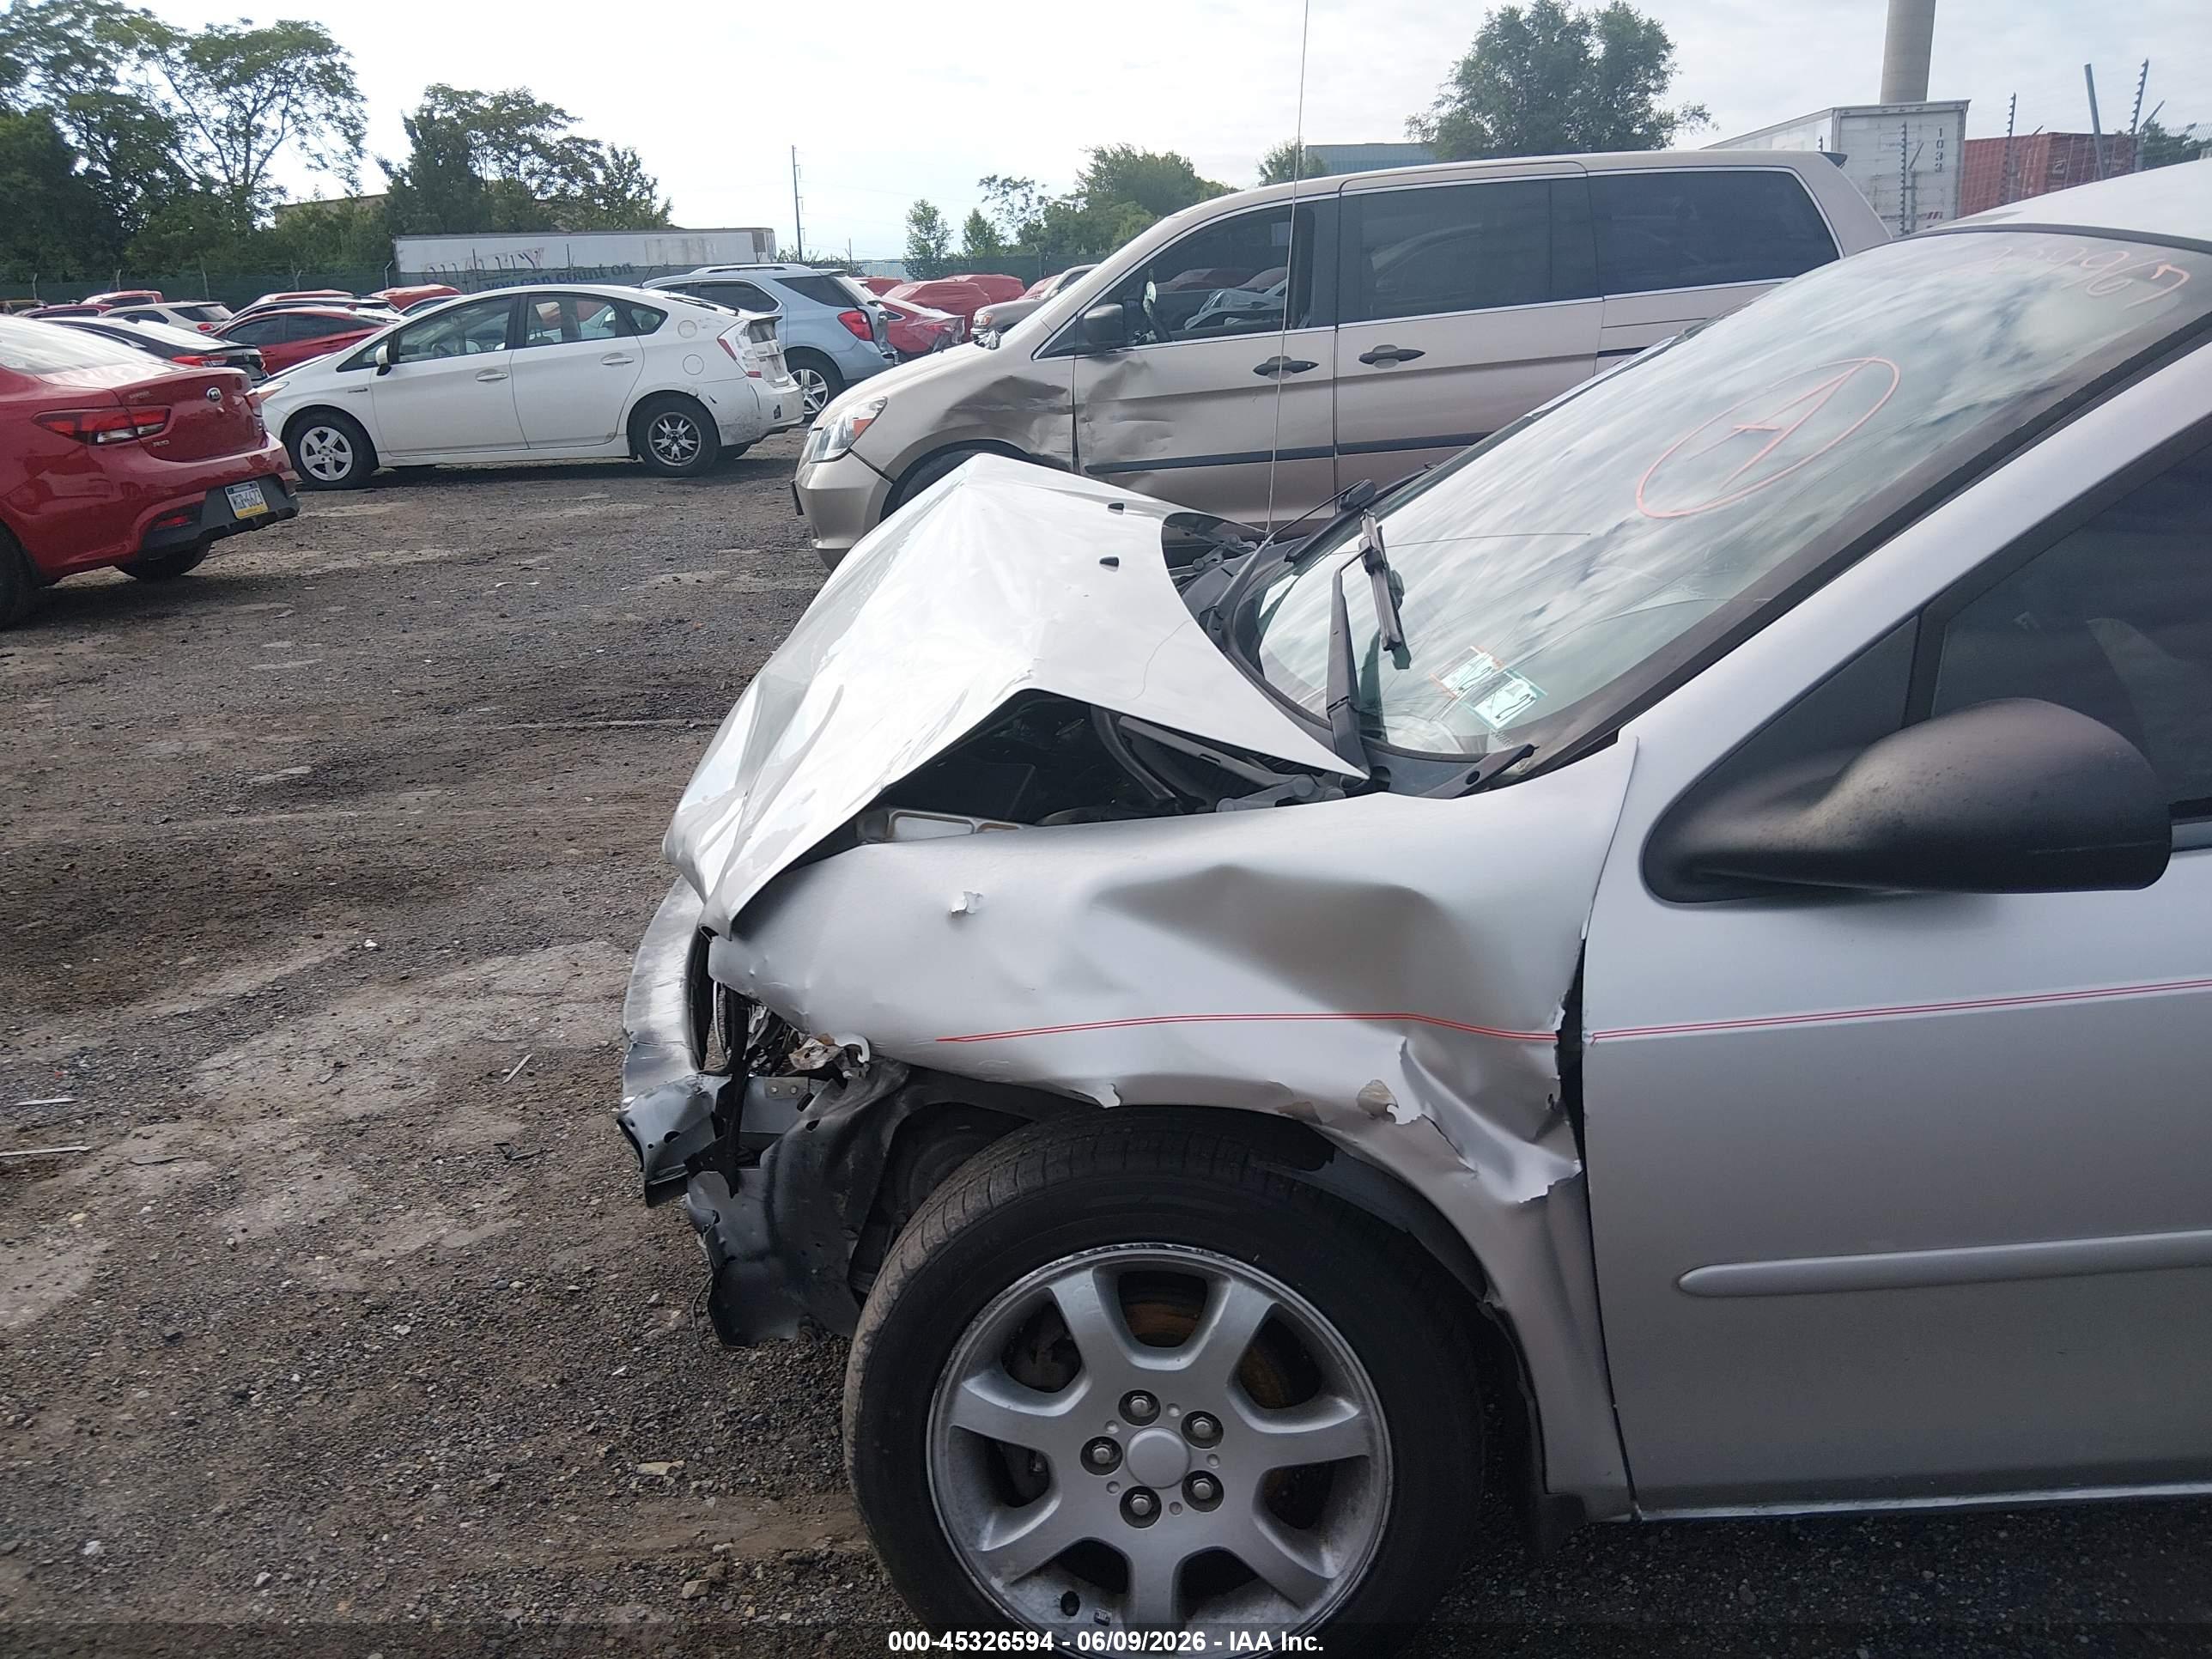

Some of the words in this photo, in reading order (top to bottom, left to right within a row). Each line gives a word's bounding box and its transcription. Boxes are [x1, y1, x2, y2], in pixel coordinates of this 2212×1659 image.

[520, 274, 551, 289] can
[555, 263, 608, 283] count
[611, 262, 635, 276] on
